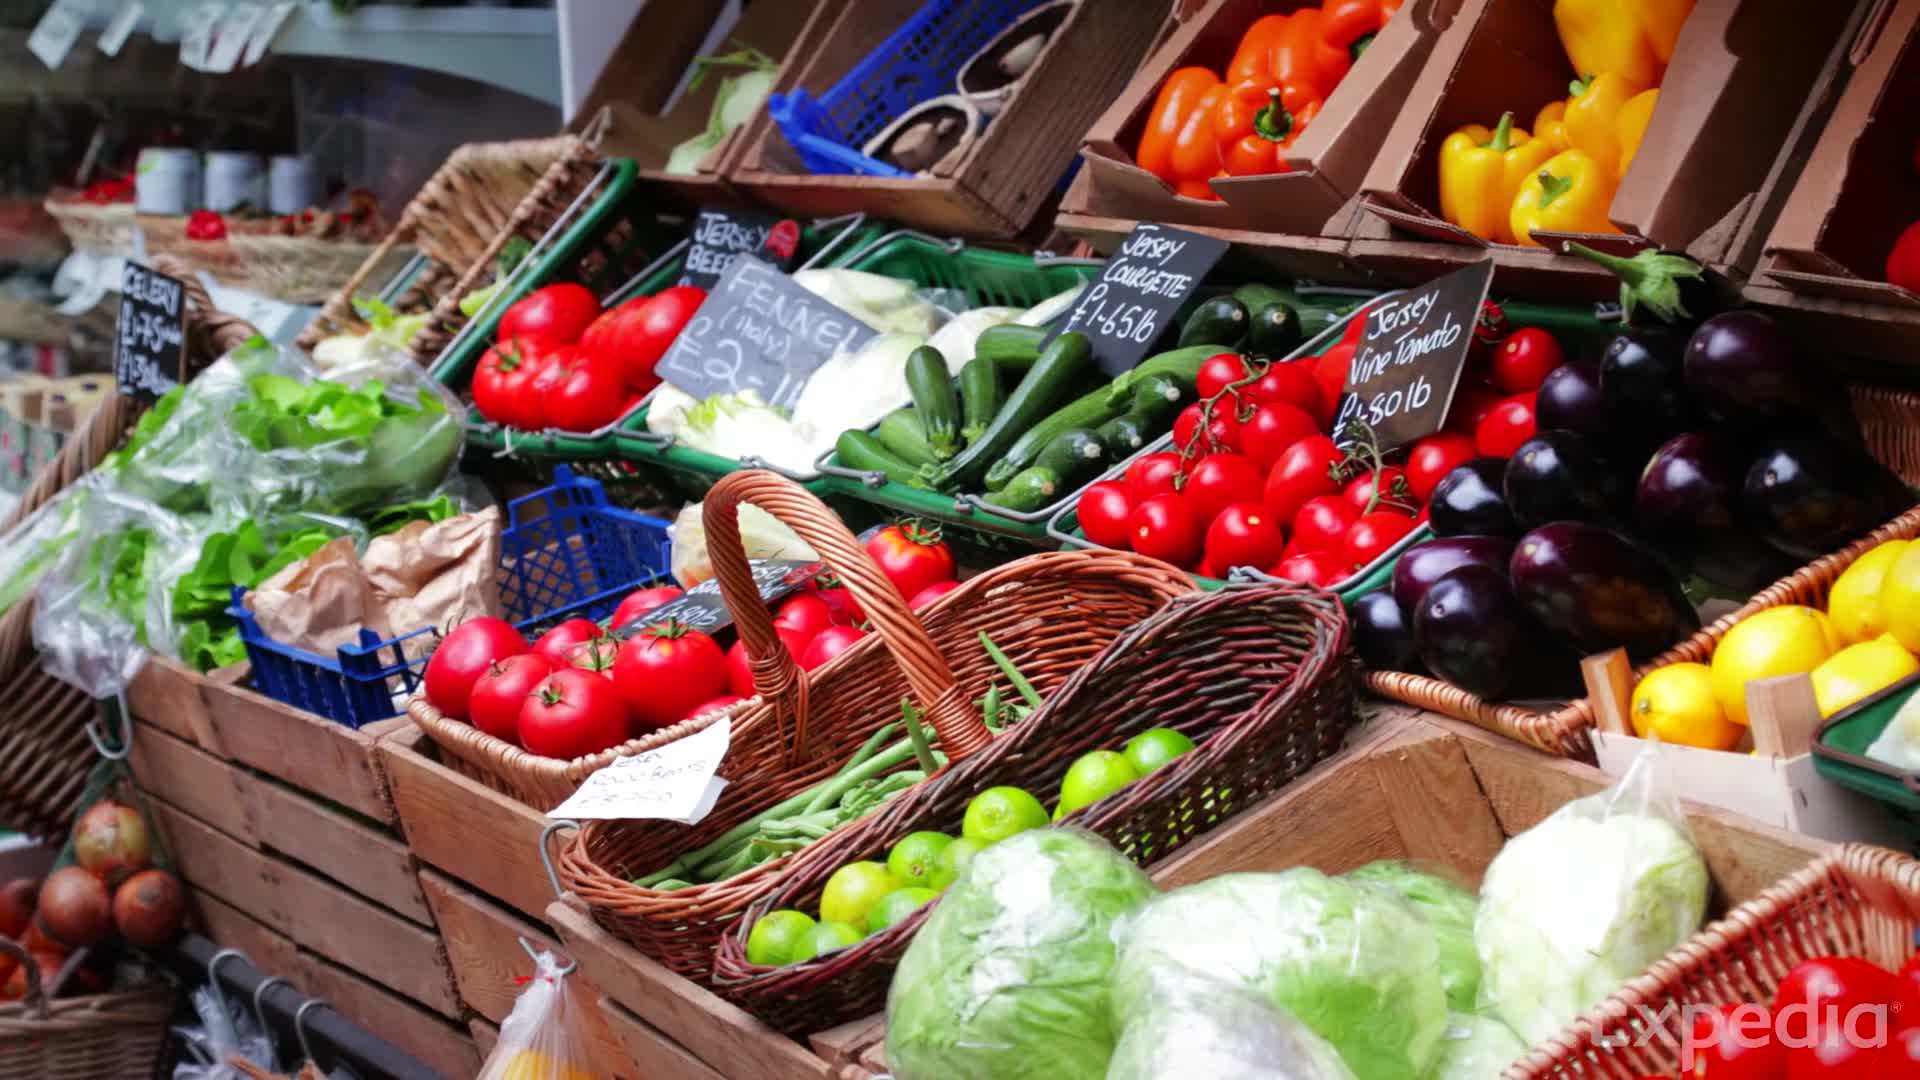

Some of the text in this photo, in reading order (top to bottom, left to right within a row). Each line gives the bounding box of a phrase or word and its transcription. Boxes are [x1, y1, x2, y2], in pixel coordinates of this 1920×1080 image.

[1103, 256, 1193, 299] COURGETTE
[1367, 289, 1441, 341] Jersey
[1349, 311, 1462, 386] Vine Tomato
